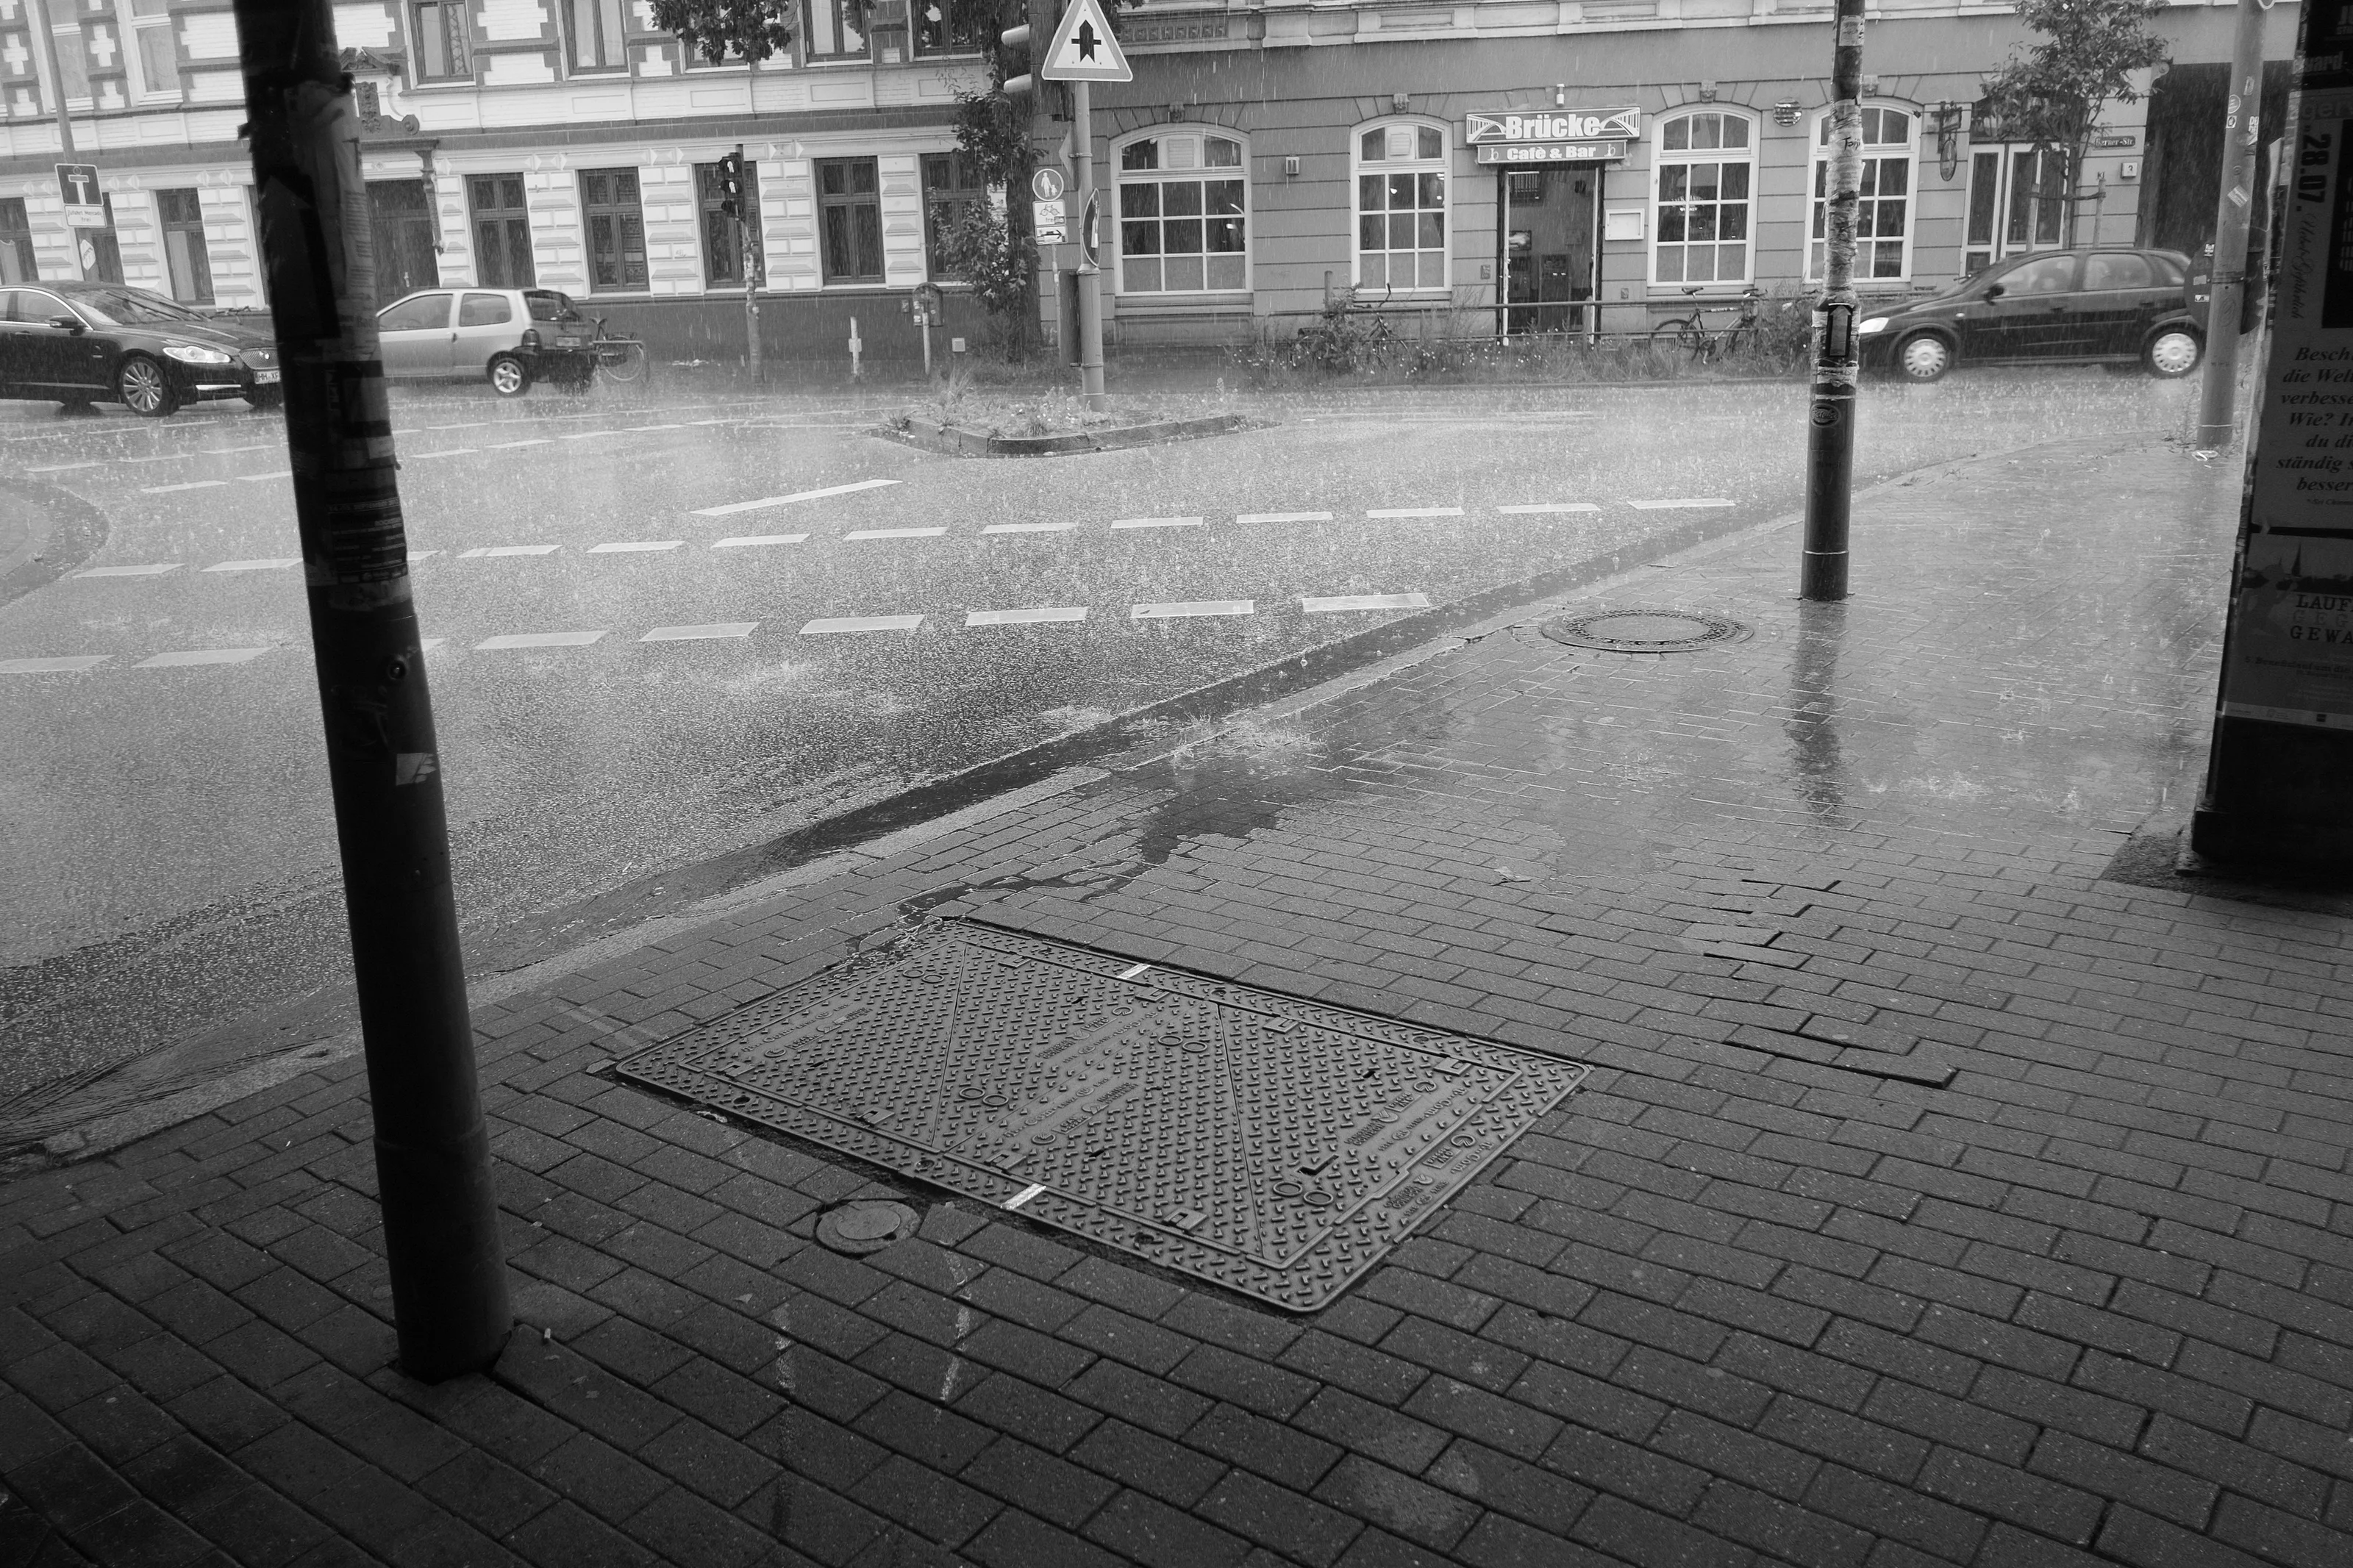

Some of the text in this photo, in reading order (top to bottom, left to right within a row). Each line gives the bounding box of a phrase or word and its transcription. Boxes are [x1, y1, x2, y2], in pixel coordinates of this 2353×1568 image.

[1505, 113, 1601, 140] Brücke
[1549, 147, 1563, 159] &
[1565, 146, 1596, 159] Bar
[2294, 346, 2353, 361] Besch
[2283, 368, 2311, 382] die
[2290, 412, 2334, 426] Wie?
[2306, 434, 2330, 448] du
[2276, 456, 2343, 473] ständig
[2296, 594, 2353, 612] LAUF
